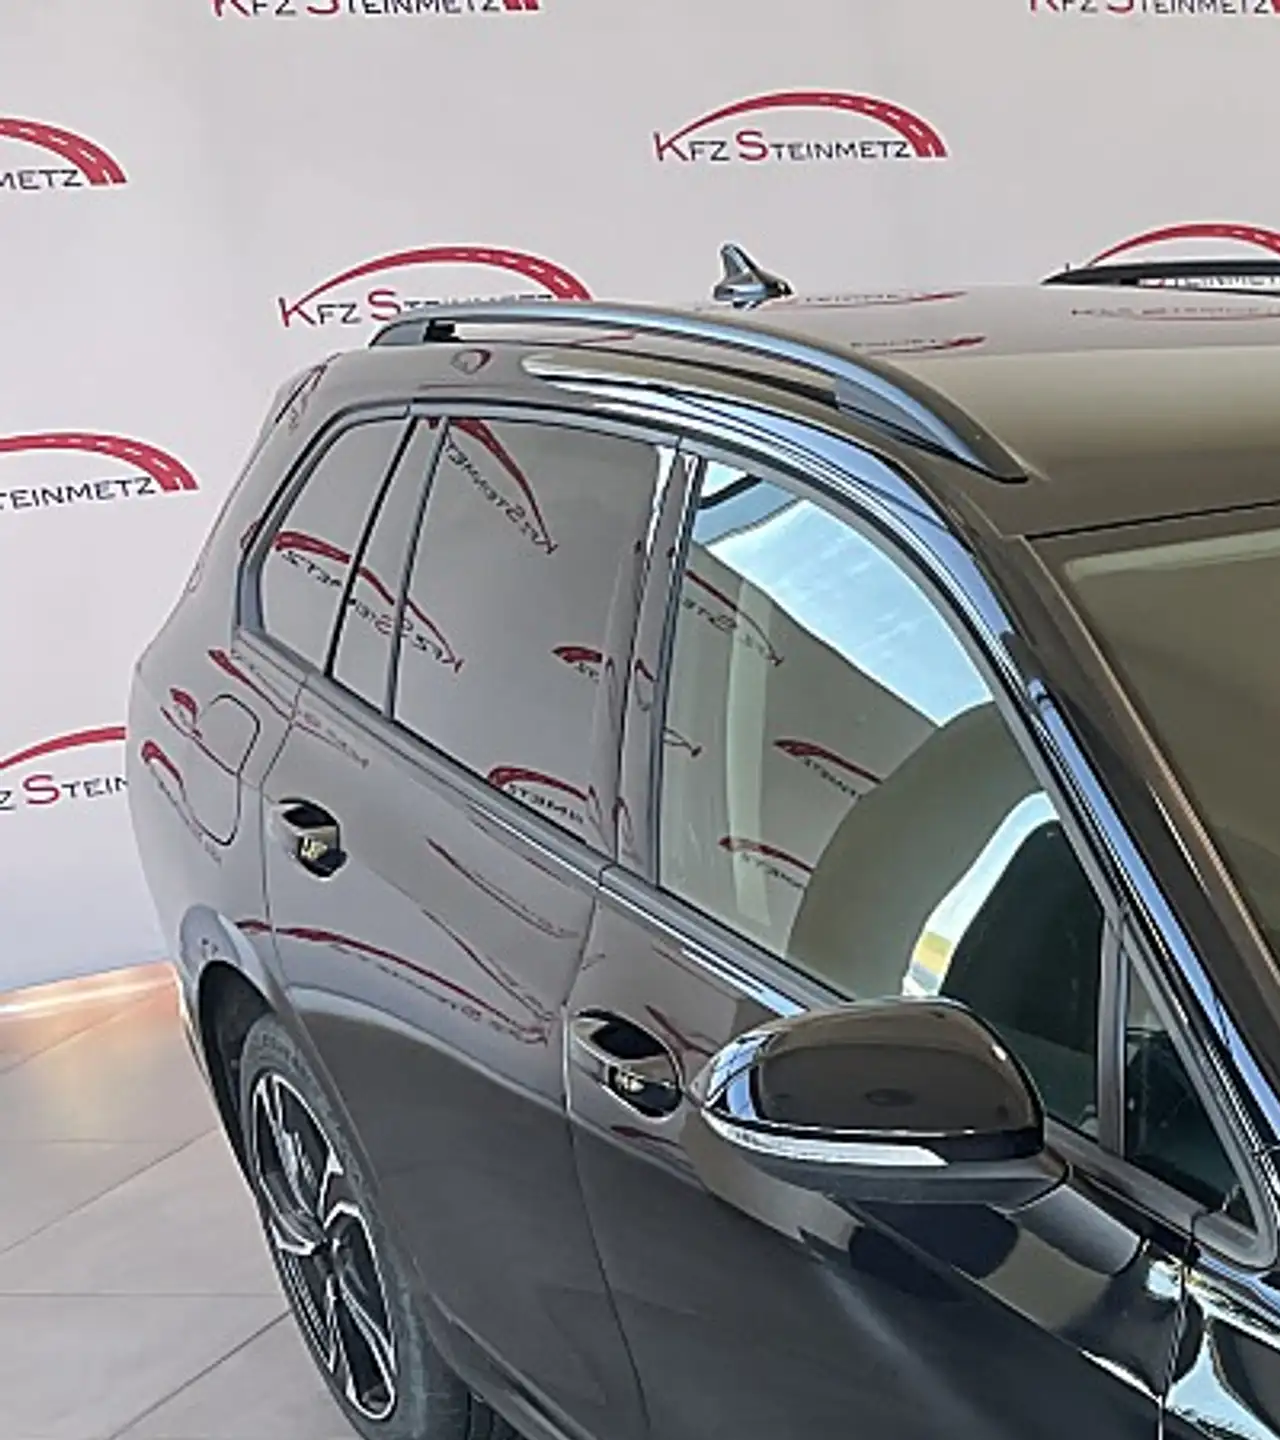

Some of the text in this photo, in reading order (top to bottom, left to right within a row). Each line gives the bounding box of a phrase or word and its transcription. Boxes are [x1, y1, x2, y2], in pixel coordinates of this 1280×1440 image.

[653, 130, 912, 162] KFZ STEINMETZ
[279, 296, 362, 327] KFZ
